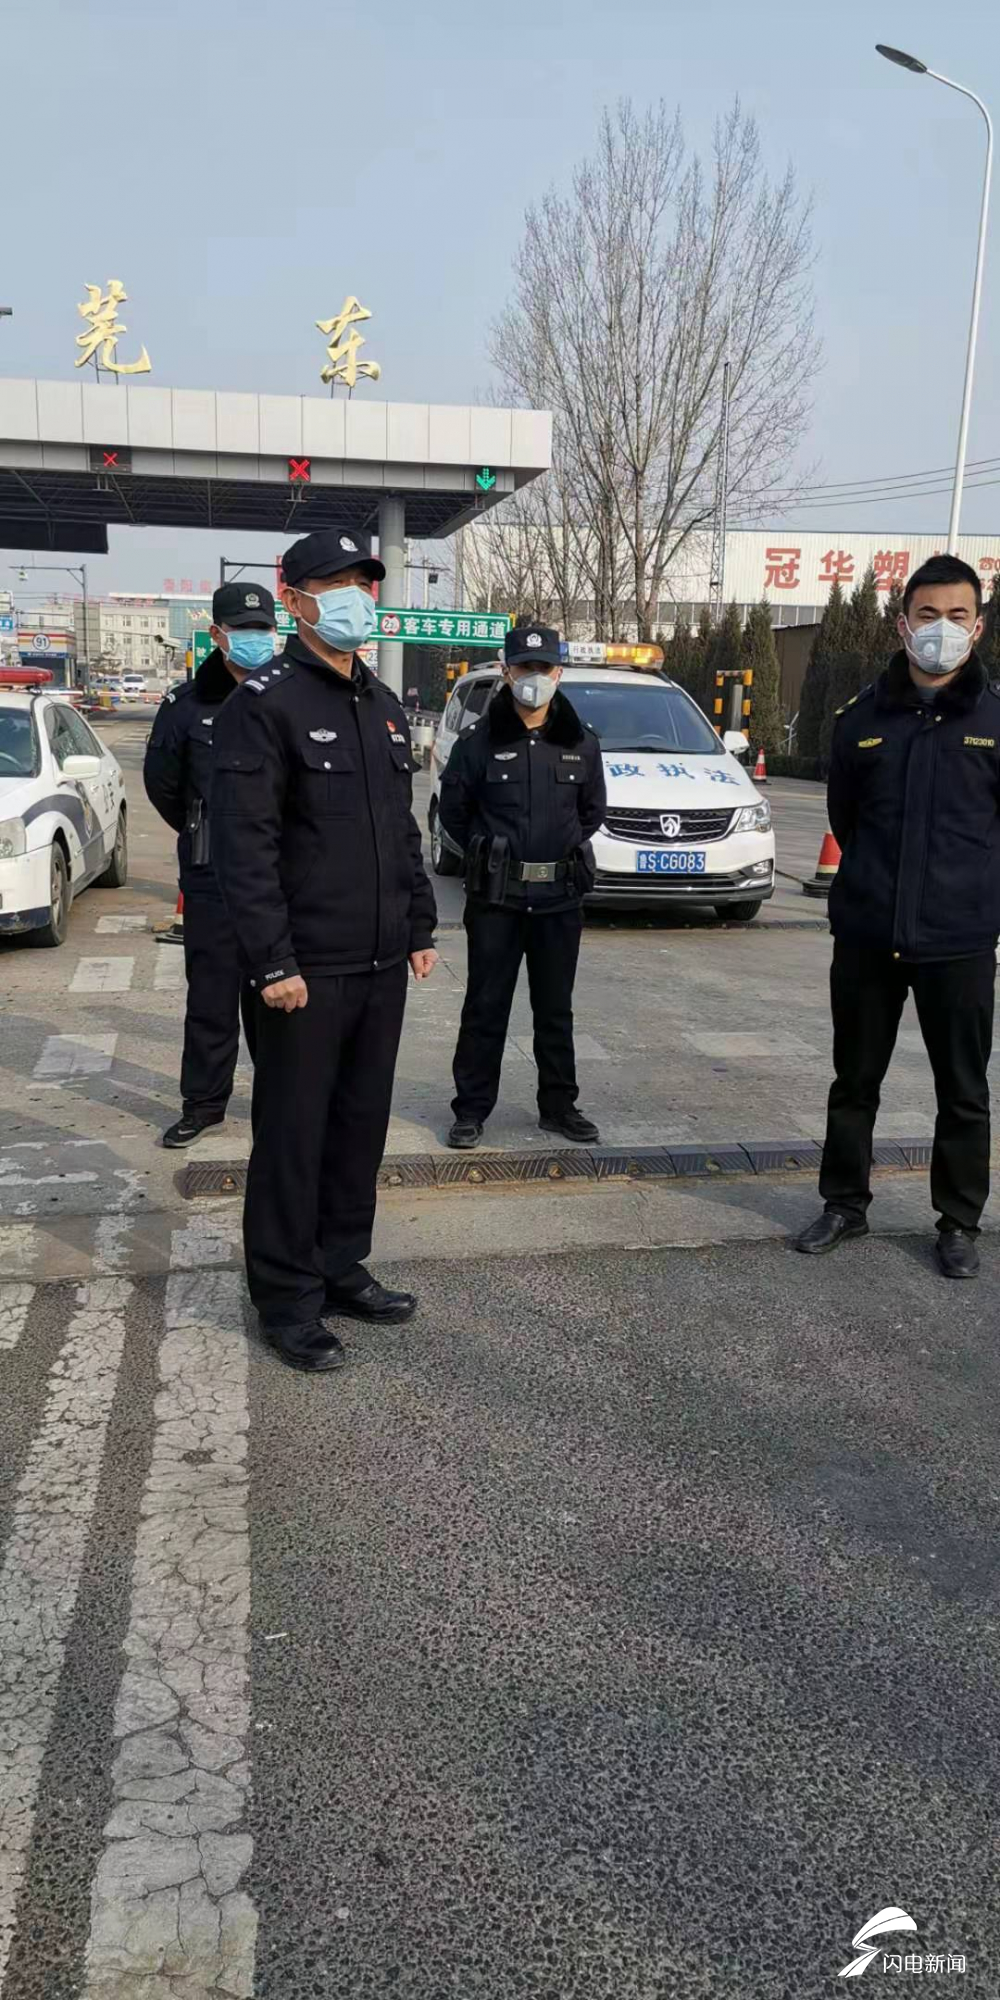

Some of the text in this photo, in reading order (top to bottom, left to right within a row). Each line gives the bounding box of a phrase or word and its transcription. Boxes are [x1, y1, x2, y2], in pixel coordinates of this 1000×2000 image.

[763, 547, 961, 592] 冠华塑
[404, 617, 506, 639] 客车专用通道
[36, 637, 47, 648] 91
[264, 969, 285, 980] POLICE
